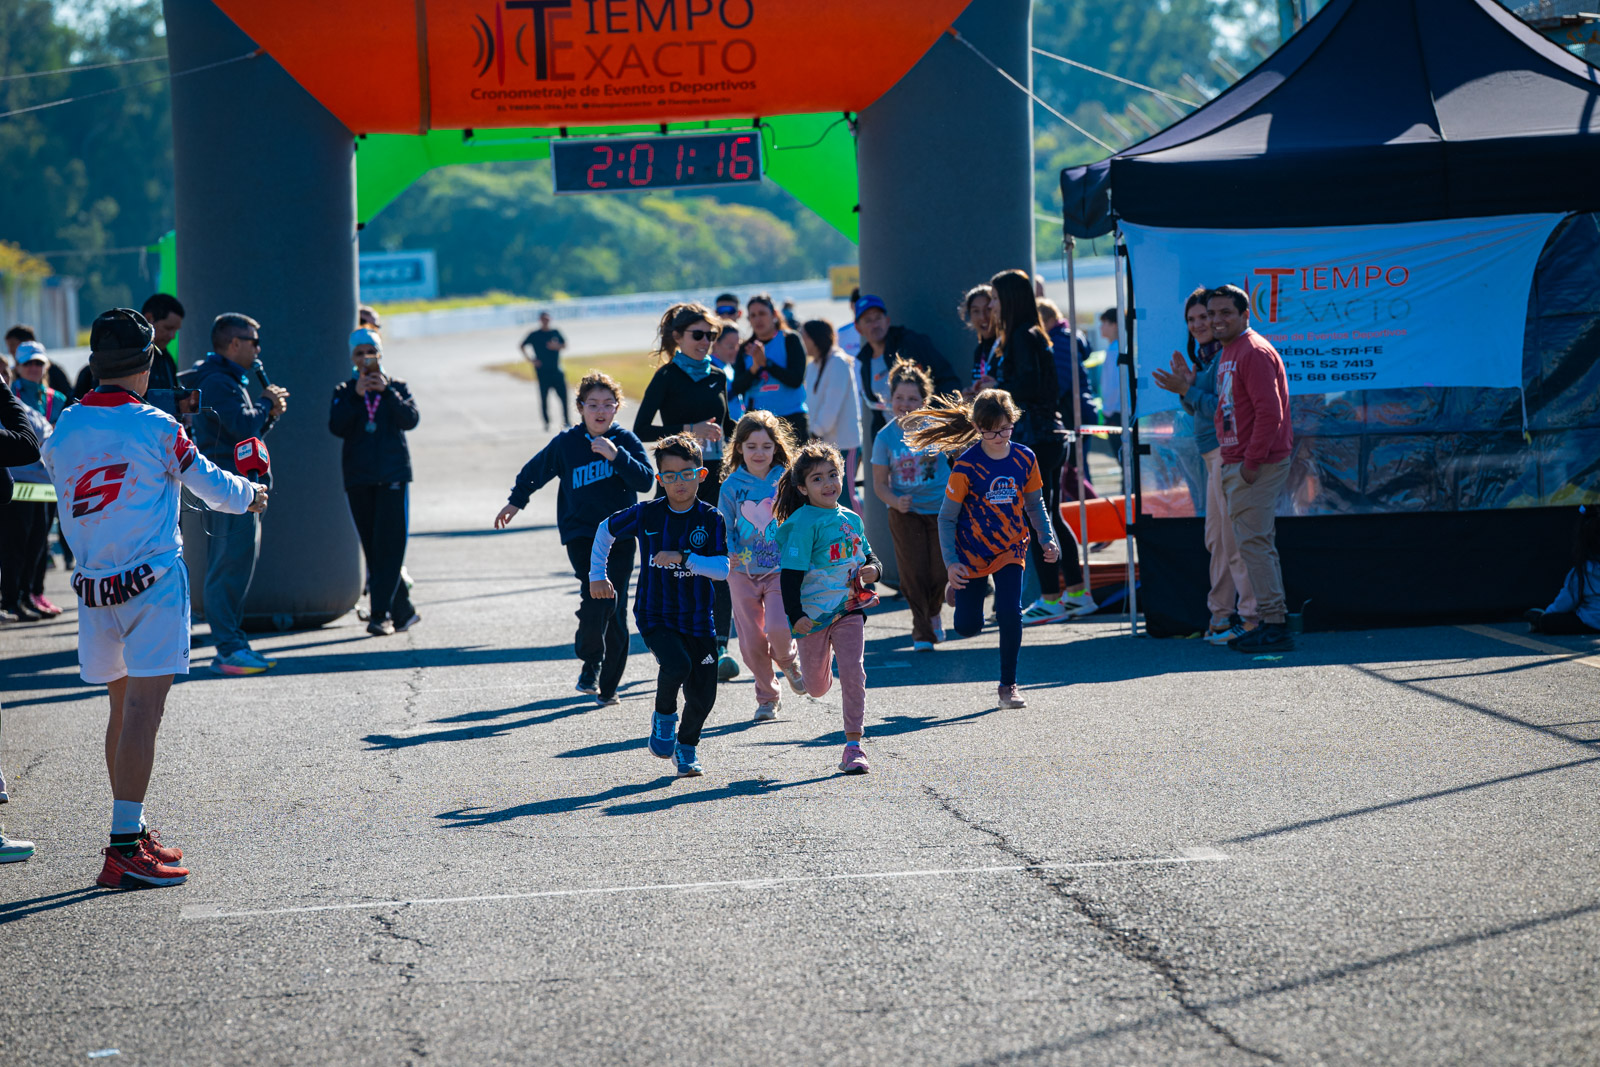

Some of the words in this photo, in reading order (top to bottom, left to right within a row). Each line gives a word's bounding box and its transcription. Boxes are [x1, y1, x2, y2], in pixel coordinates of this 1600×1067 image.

[549, 10, 758, 81] EXACTO
[470, 86, 577, 100] Cronometraje
[580, 85, 600, 97] de
[604, 83, 666, 97] Eventos
[669, 79, 757, 95] Deportivos
[587, 136, 754, 188] 2:01:16
[1291, 332, 1305, 341] de
[1307, 330, 1349, 341] Eventos
[1352, 328, 1407, 340] Deportivos
[1277, 345, 1383, 356] RÉBOL-STA-FE
[1319, 360, 1338, 369] 52
[1343, 359, 1374, 369] 7413
[1307, 373, 1326, 382] 68
[1331, 372, 1377, 382] 66557
